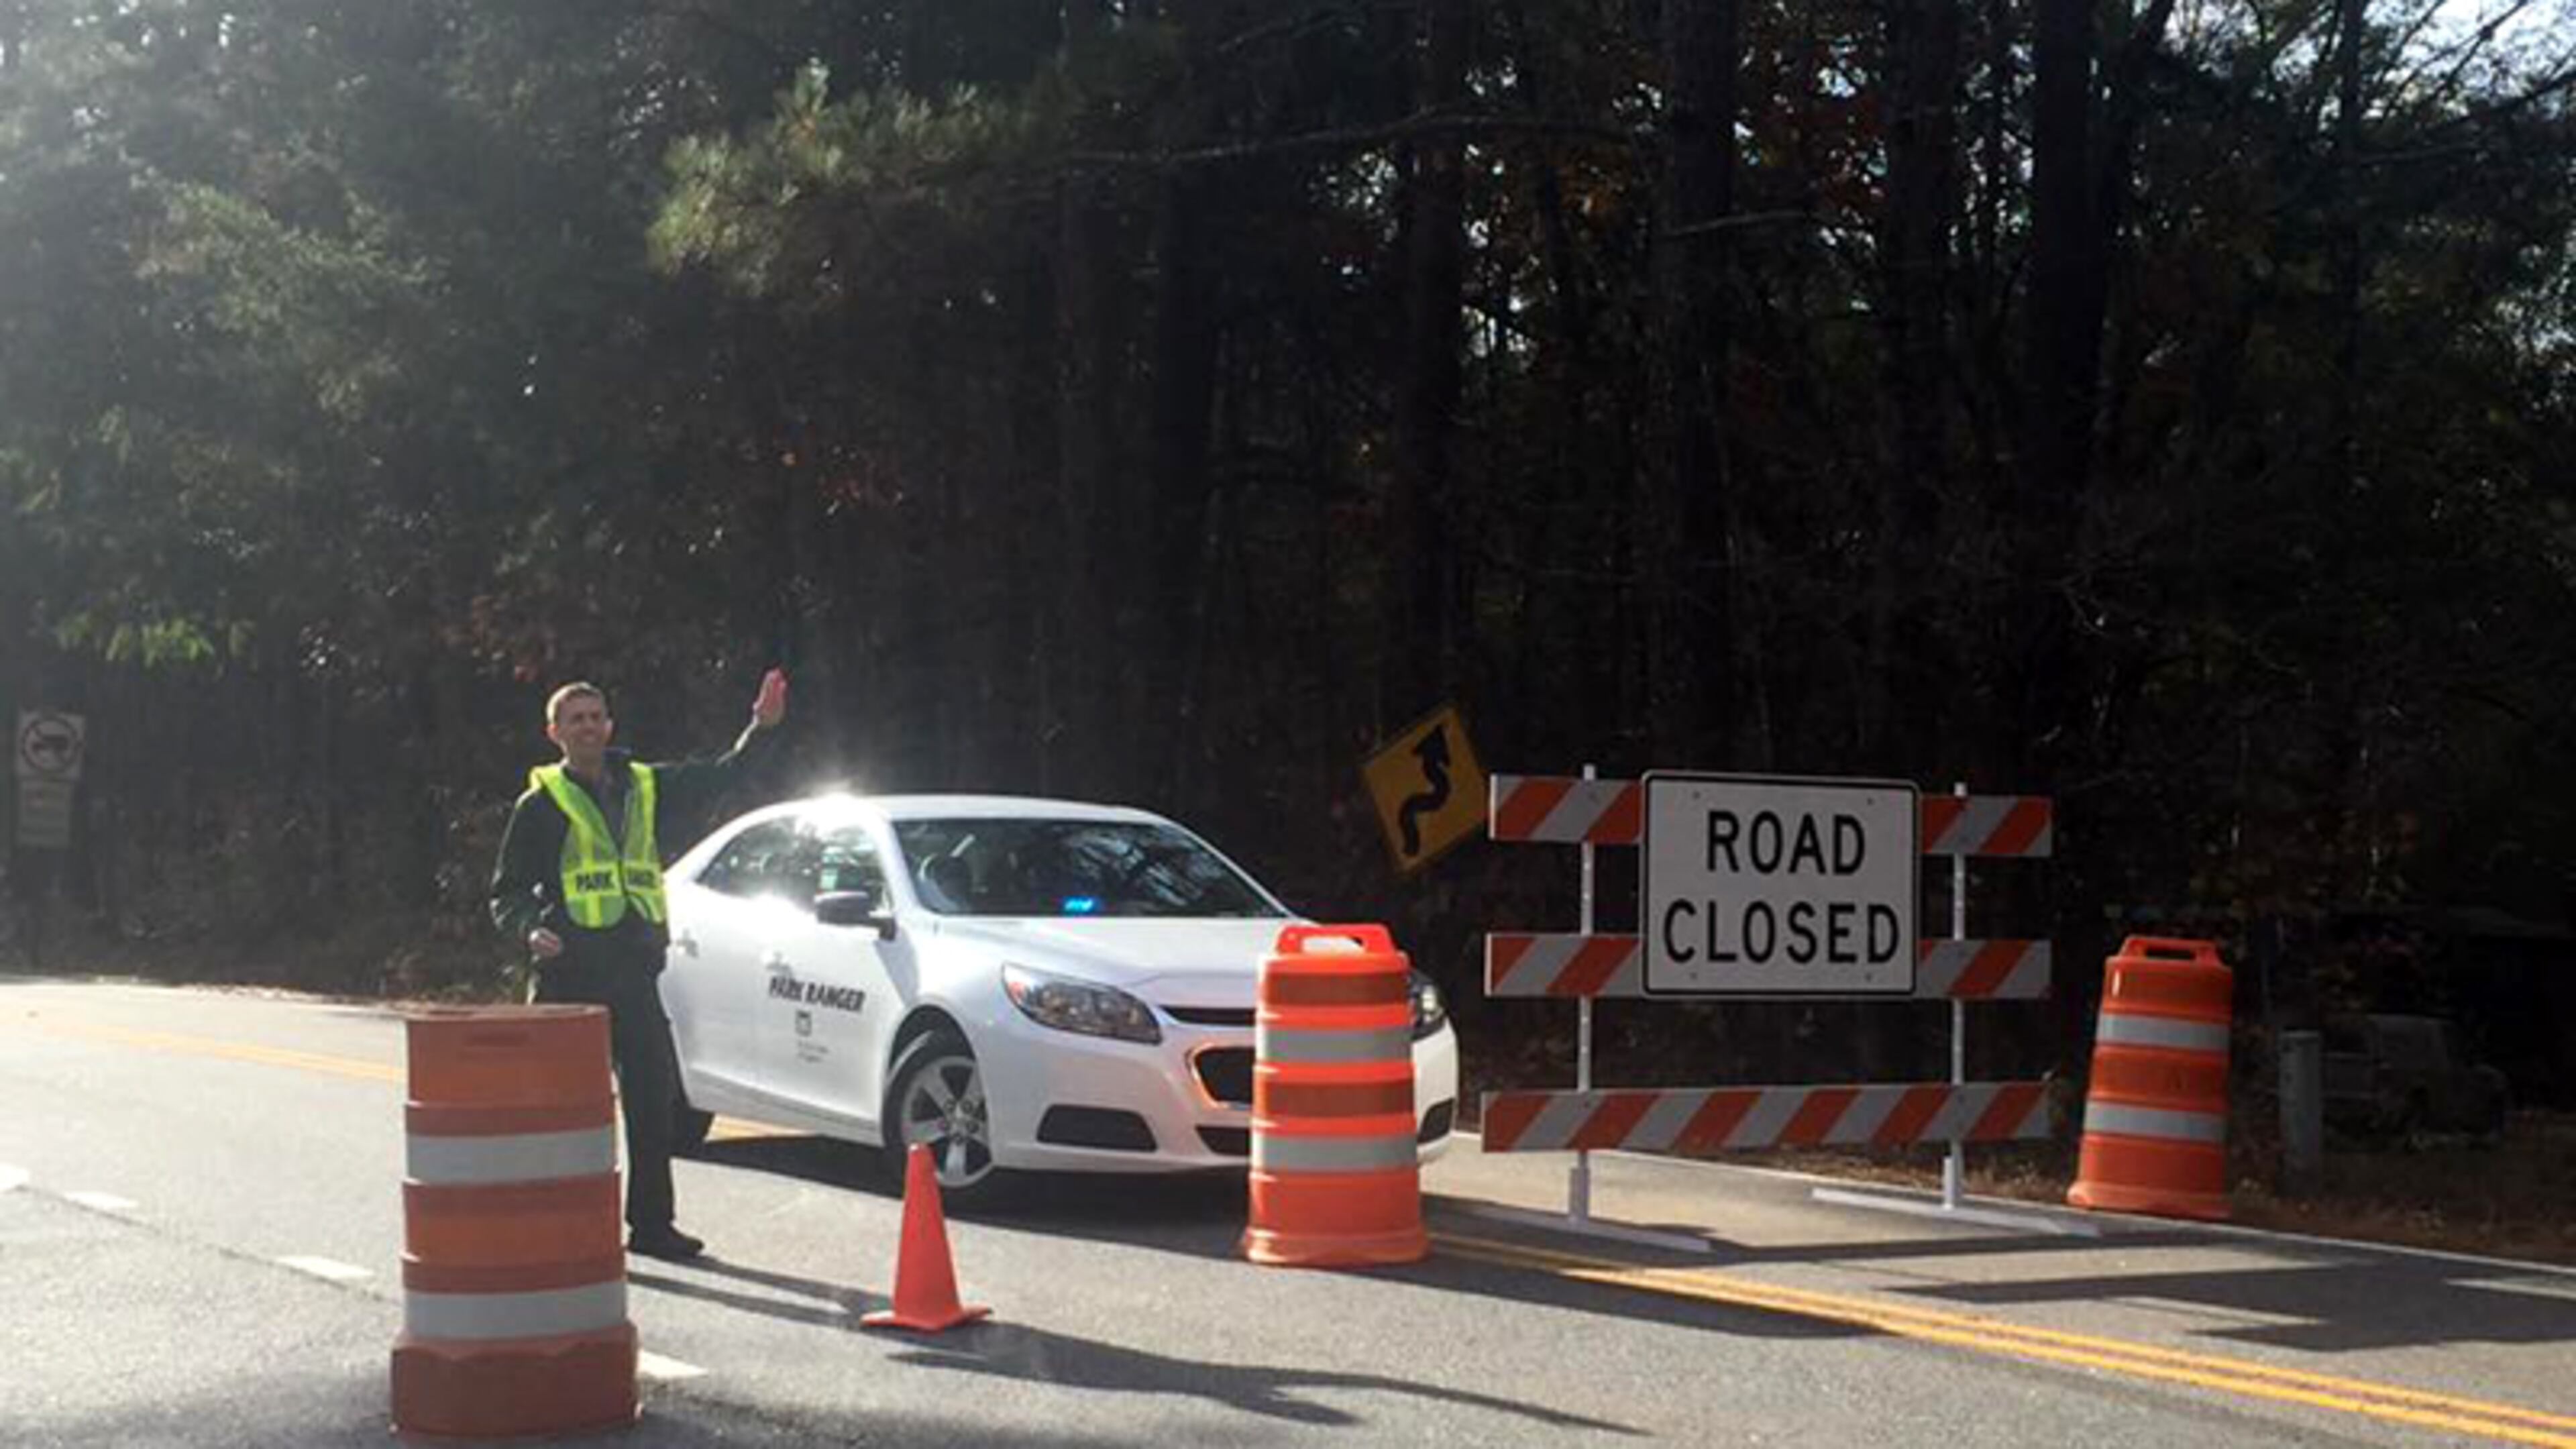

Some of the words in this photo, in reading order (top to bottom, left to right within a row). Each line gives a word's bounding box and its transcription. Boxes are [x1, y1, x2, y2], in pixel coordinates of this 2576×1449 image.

[1707, 810, 1865, 875] ROAD
[576, 872, 616, 894] PARK
[1664, 898, 1899, 964] CLOSED
[769, 976, 804, 1002] PARK
[806, 982, 865, 1014] RANGER
